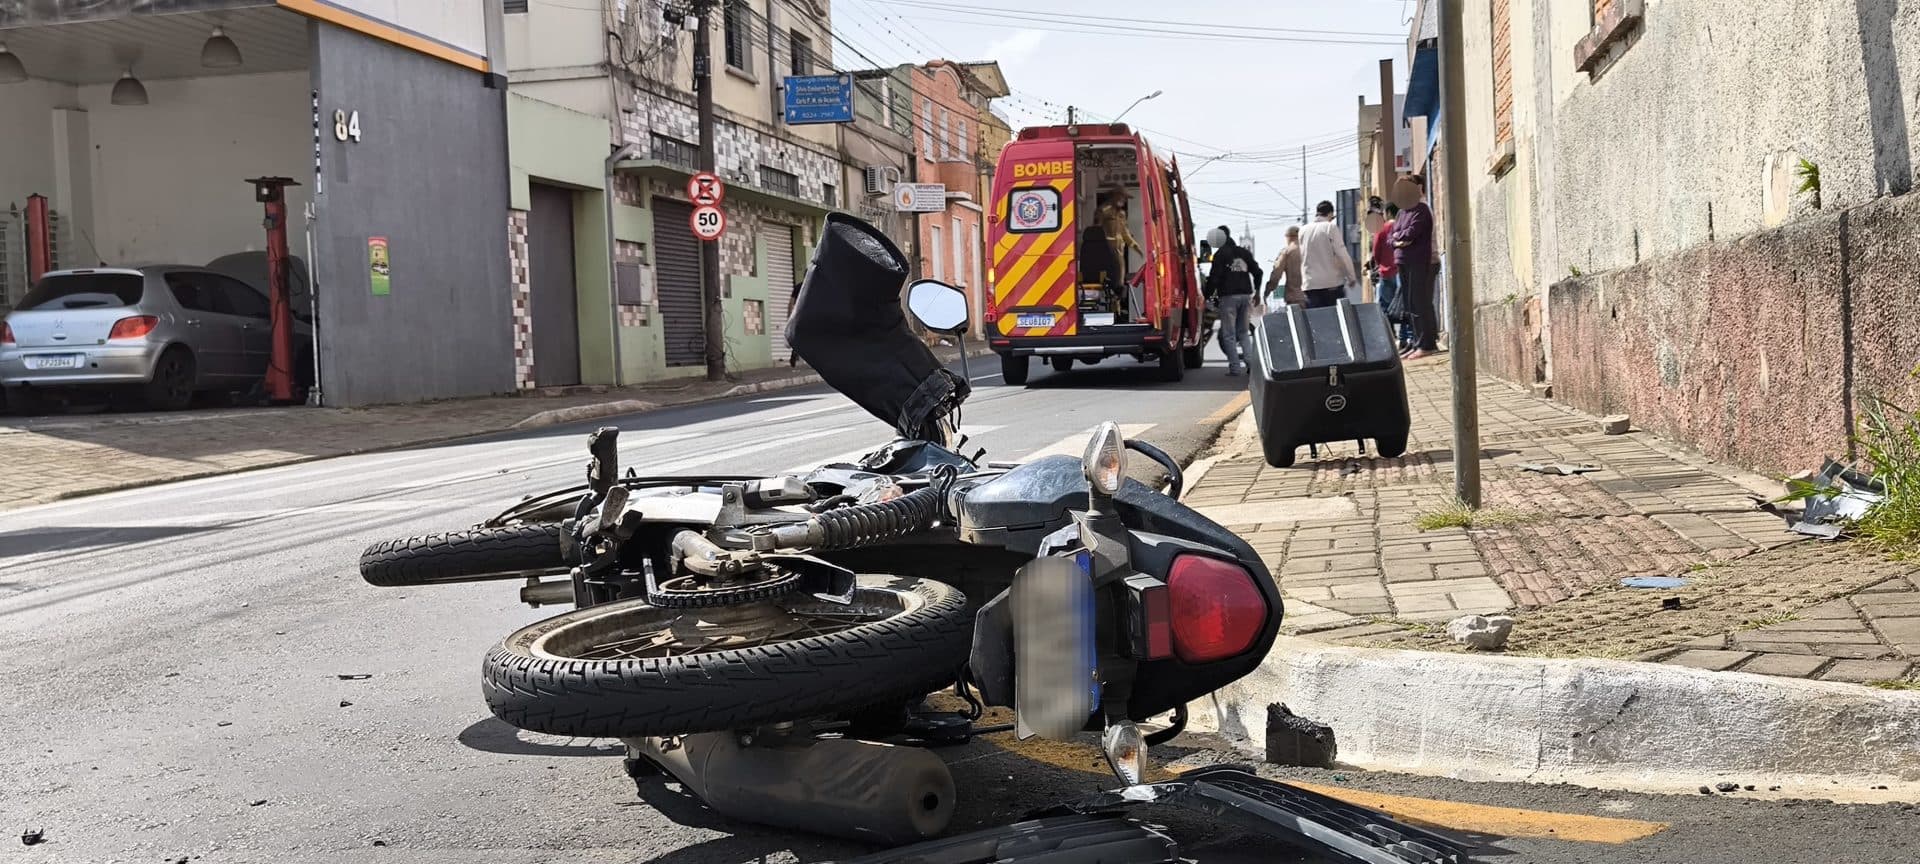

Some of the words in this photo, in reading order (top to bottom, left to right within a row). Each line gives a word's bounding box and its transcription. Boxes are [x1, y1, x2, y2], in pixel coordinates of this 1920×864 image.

[335, 108, 361, 142] 84
[1014, 161, 1073, 177] BOMBE
[699, 212, 718, 226] 50
